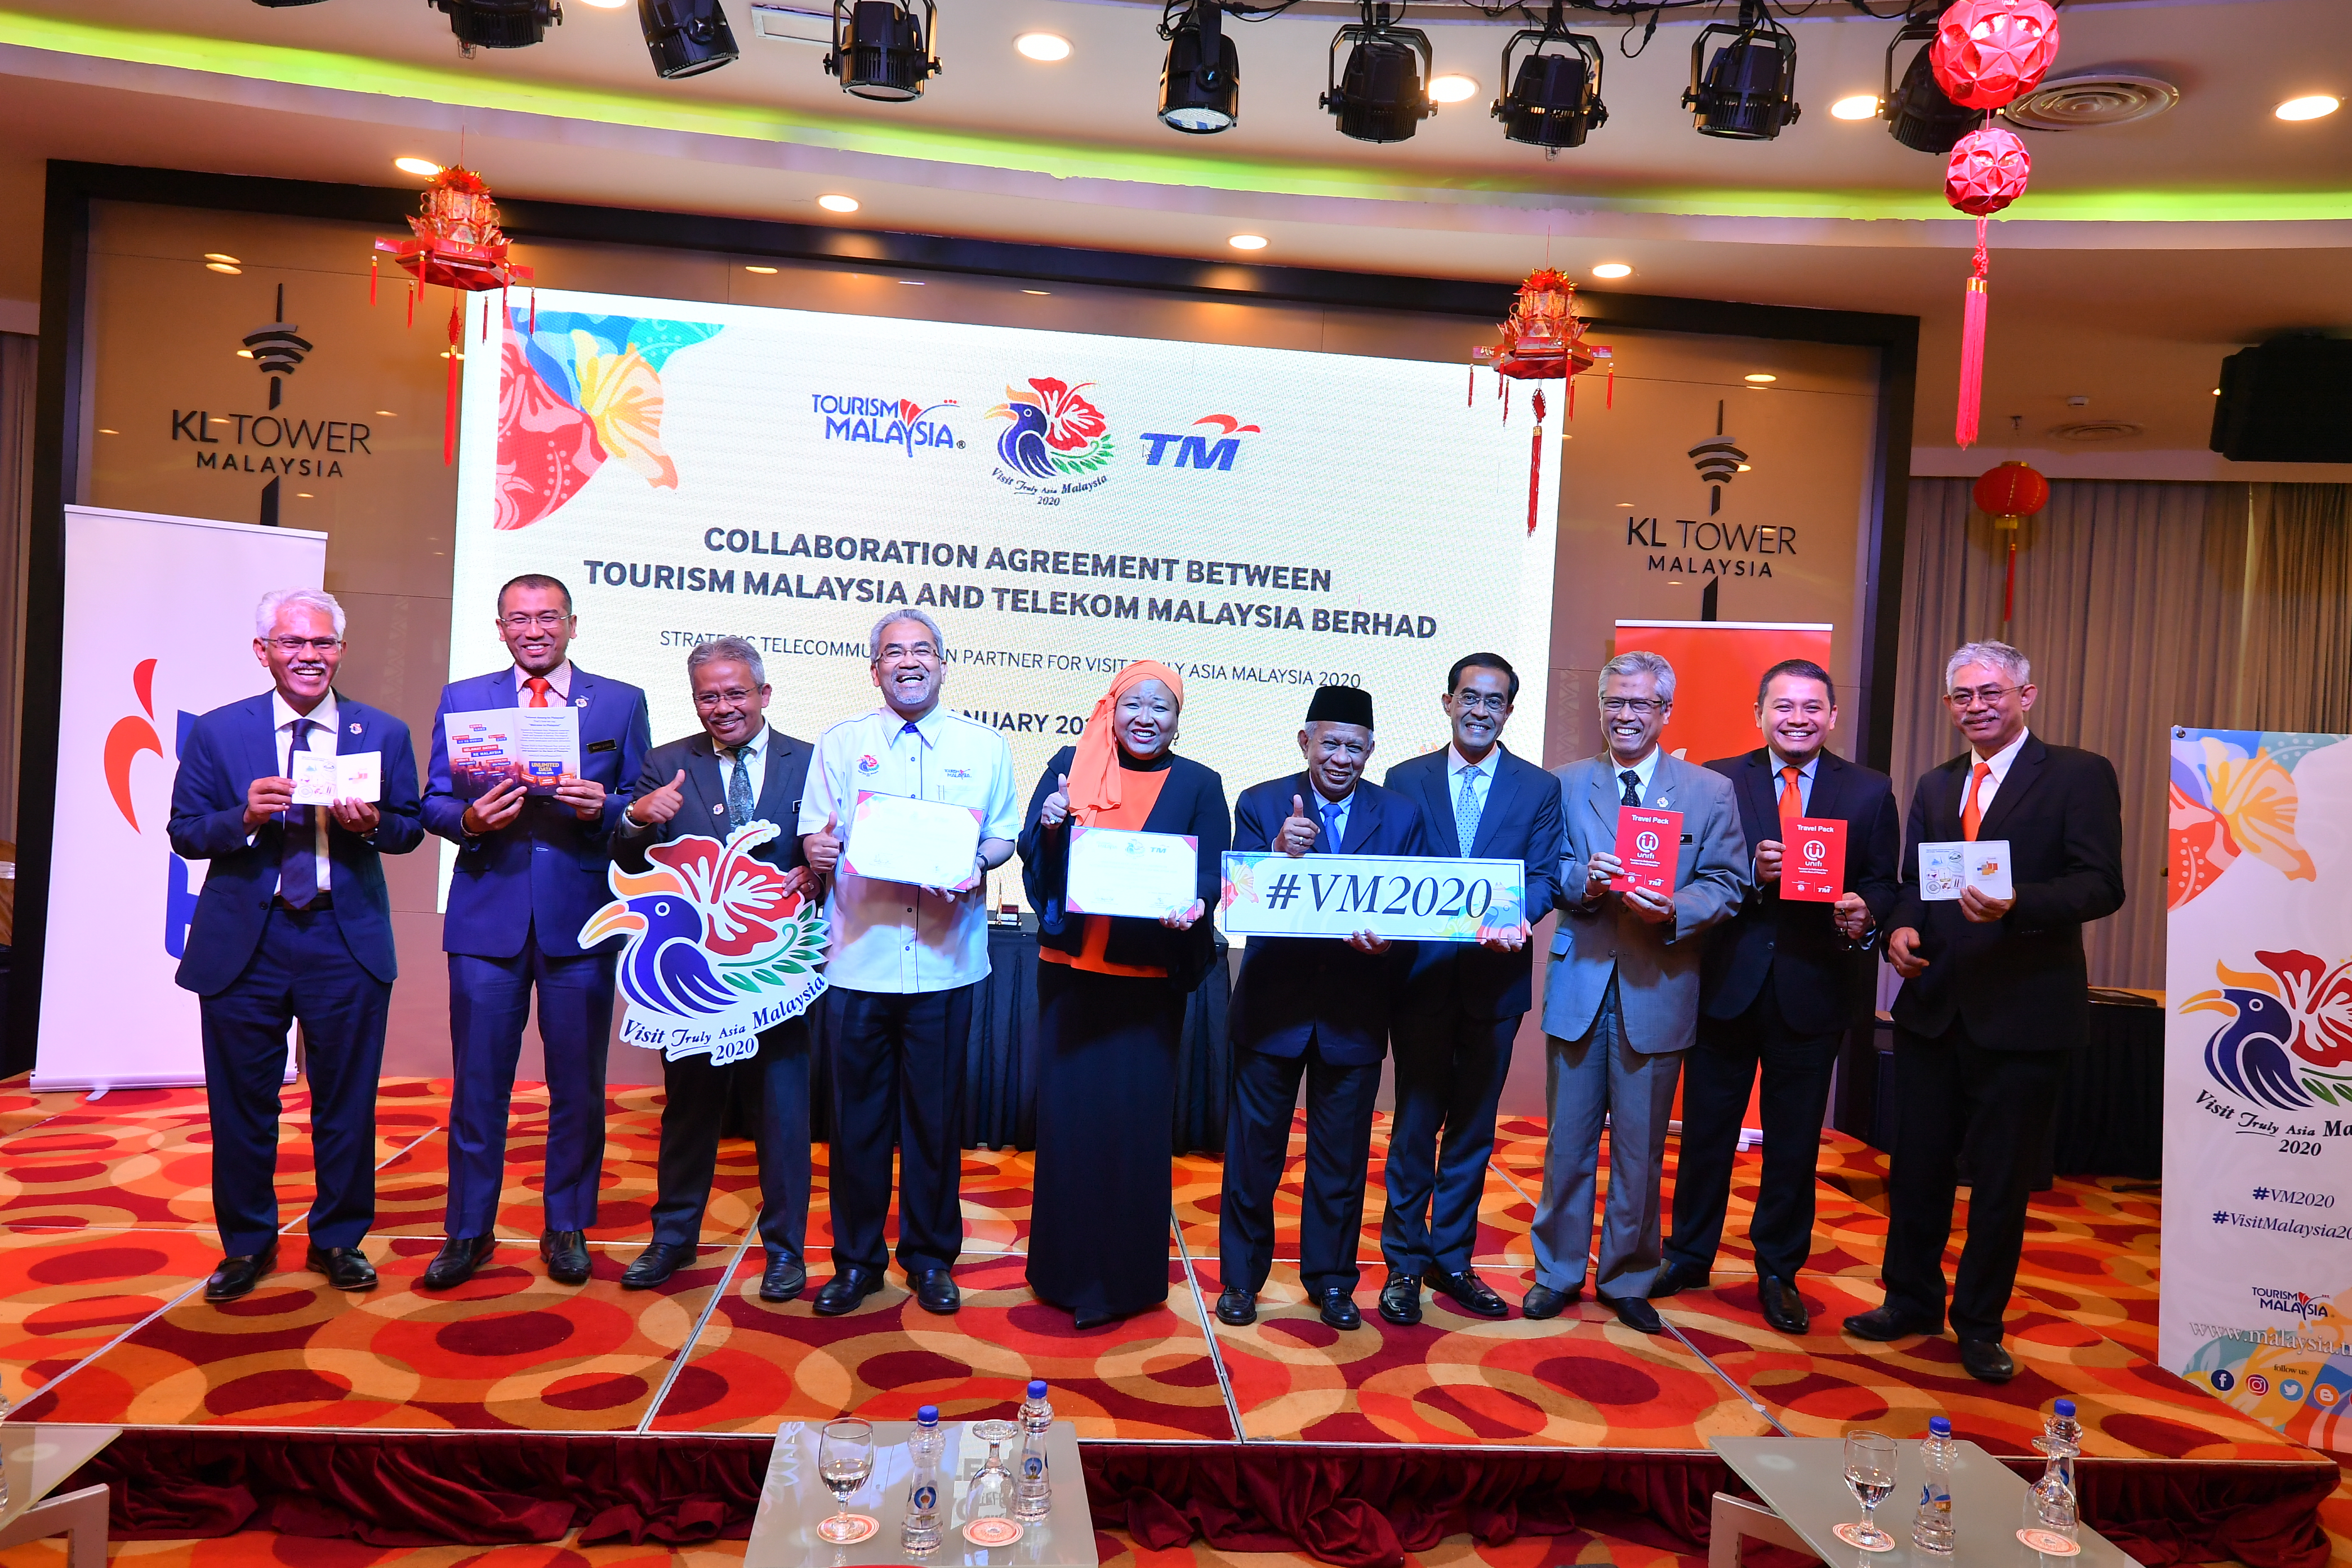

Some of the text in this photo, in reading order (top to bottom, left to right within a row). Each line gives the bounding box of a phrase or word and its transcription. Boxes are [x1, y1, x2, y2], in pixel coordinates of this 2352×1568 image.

[812, 394, 899, 418] TOURISM
[172, 409, 372, 455] KL TOWER
[197, 452, 343, 478] MALAYSIA
[1139, 432, 1241, 472] TM
[992, 467, 1014, 485] Visit
[1061, 475, 1108, 495] Malaysia
[1036, 496, 1061, 506] 2020
[1627, 516, 1797, 555] KL TOWER
[704, 527, 1331, 592] COLLABORATION AGREEMENT BETWEEN
[1648, 555, 1772, 578] MALAYSIA
[583, 560, 1437, 639] TOURISM MALAYSIA AND TELEKOM MALAYSIA BERHAD
[660, 630, 756, 647] STRAT
[964, 649, 1043, 669] PARTNER
[1048, 654, 1081, 670] FOR
[1086, 657, 1128, 672] VISIT
[1188, 663, 1227, 680] ASIA
[1232, 666, 1314, 685] MALAYSIA
[1319, 671, 1361, 688] 2020
[1631, 814, 1652, 823] Travel
[1266, 872, 1493, 919] #VM2020
[623, 975, 826, 1046] Visit Truly Asia Malaysia
[715, 1038, 755, 1061] 2020
[2196, 1089, 2235, 1120] Visit
[2237, 1111, 2279, 1134] Truly
[2286, 1125, 2316, 1137] Asia
[2278, 1139, 2322, 1157] 2020
[2252, 1186, 2335, 1209] #VM2020
[2252, 1286, 2298, 1301] TOURISM
[2274, 1364, 2297, 1374] follow
